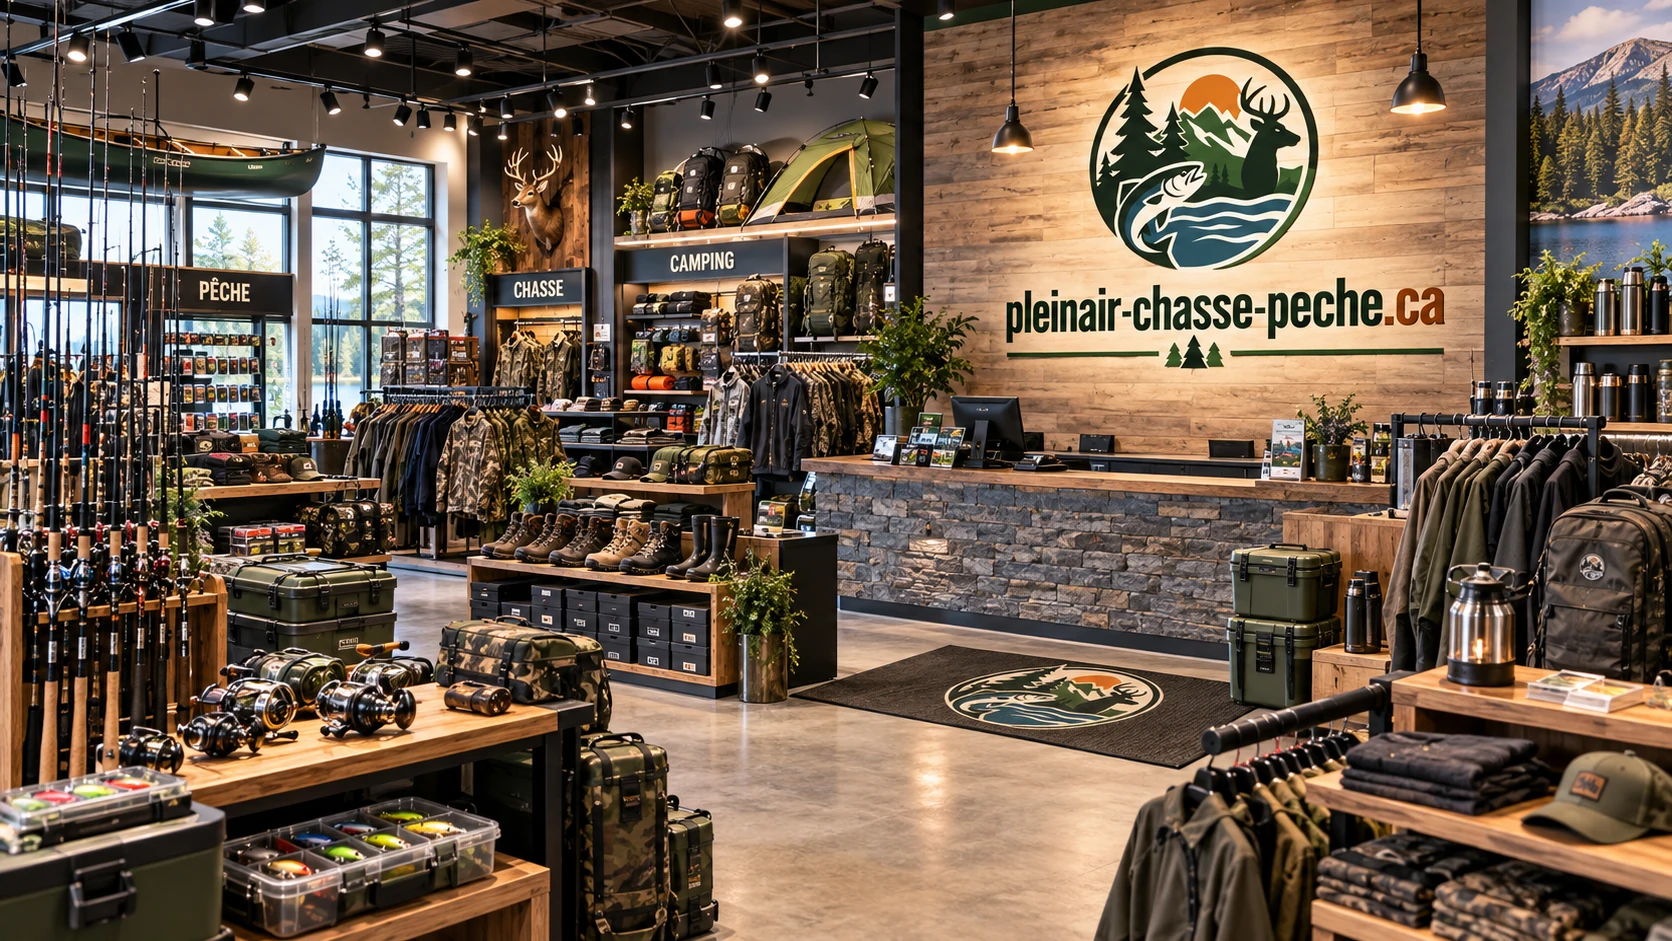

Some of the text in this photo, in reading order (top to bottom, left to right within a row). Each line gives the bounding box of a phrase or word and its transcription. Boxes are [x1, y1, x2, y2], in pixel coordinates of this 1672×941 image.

[670, 251, 735, 273] CAMPING
[199, 276, 251, 303] PÊCHE
[513, 279, 564, 299] CHASSE
[1006, 278, 1445, 344] pleinair-chasse-peche.ca
